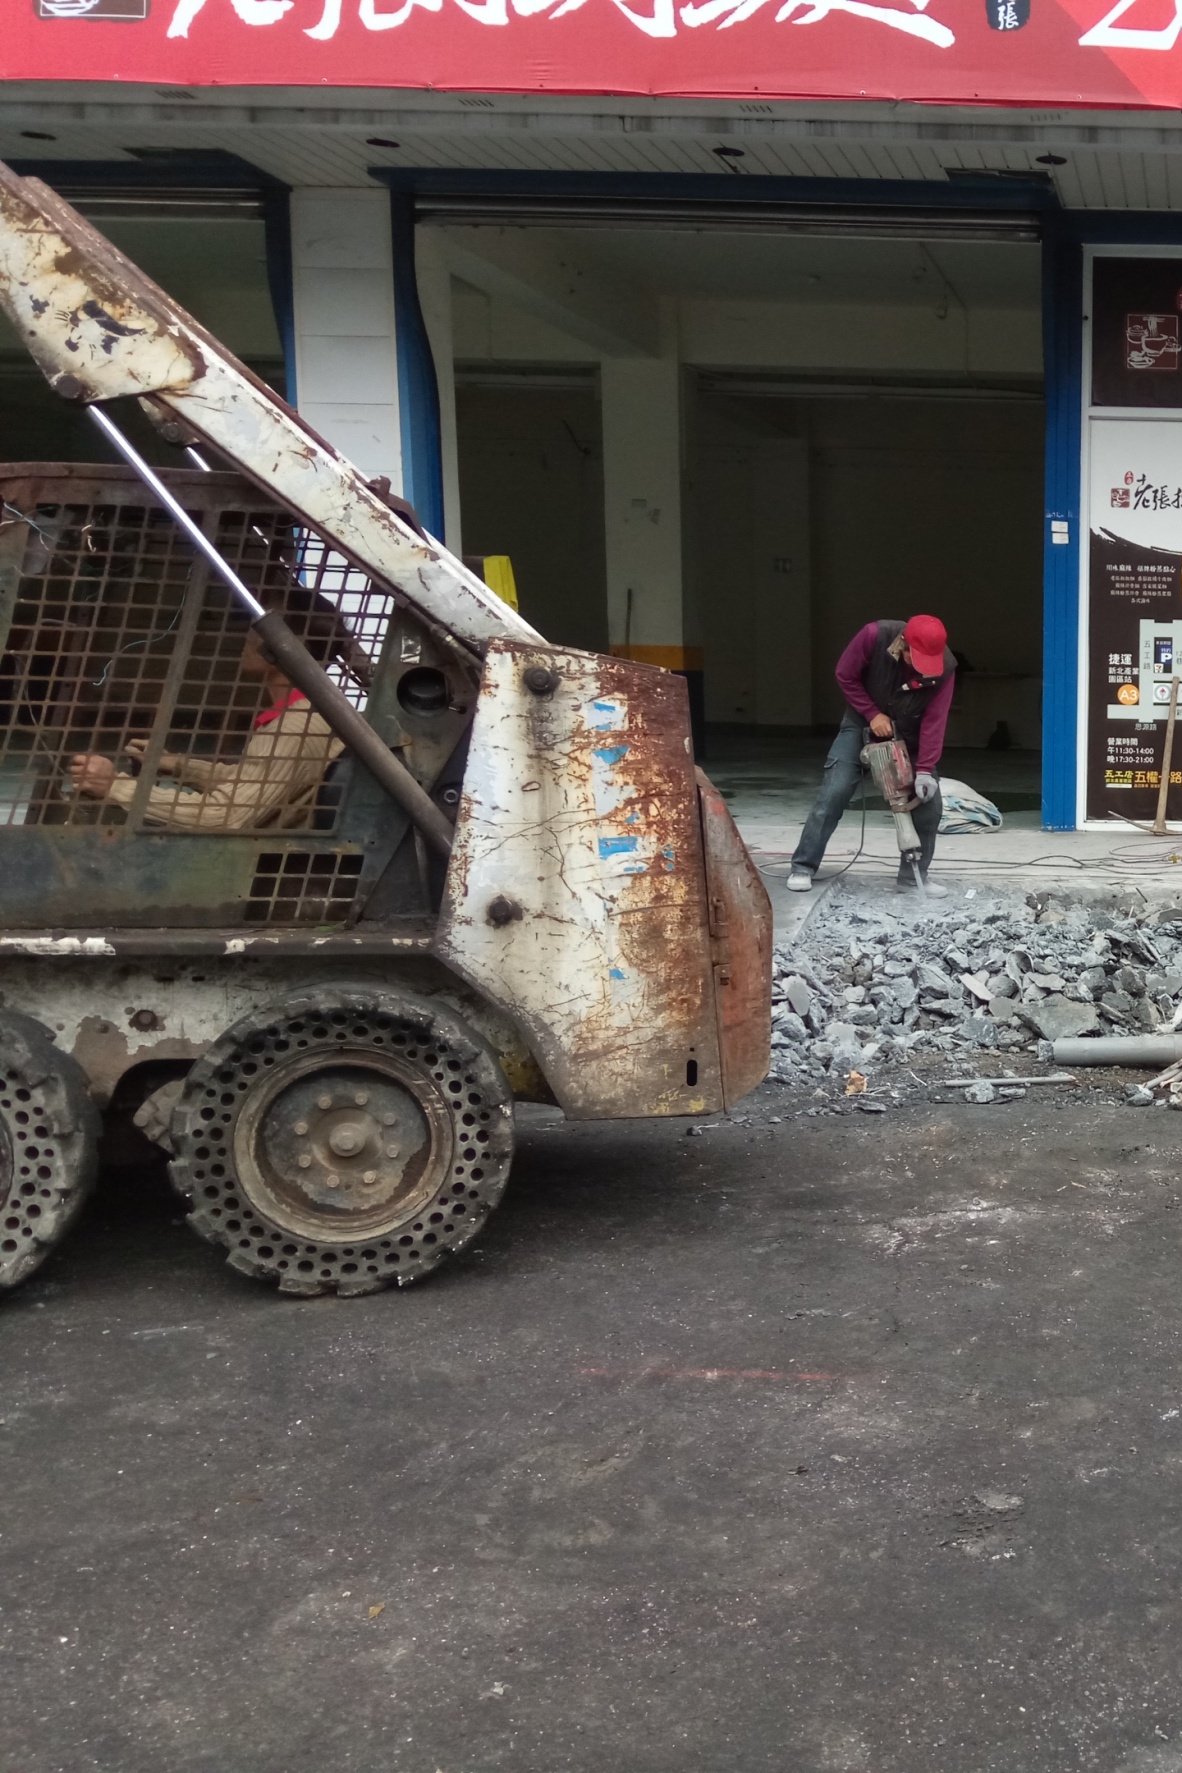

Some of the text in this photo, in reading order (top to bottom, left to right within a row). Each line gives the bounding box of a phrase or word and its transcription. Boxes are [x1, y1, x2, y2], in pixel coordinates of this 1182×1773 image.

[1108, 653, 1132, 665] 捷運
[1120, 690, 1138, 700] A3
[1104, 770, 1133, 778] 五工店
